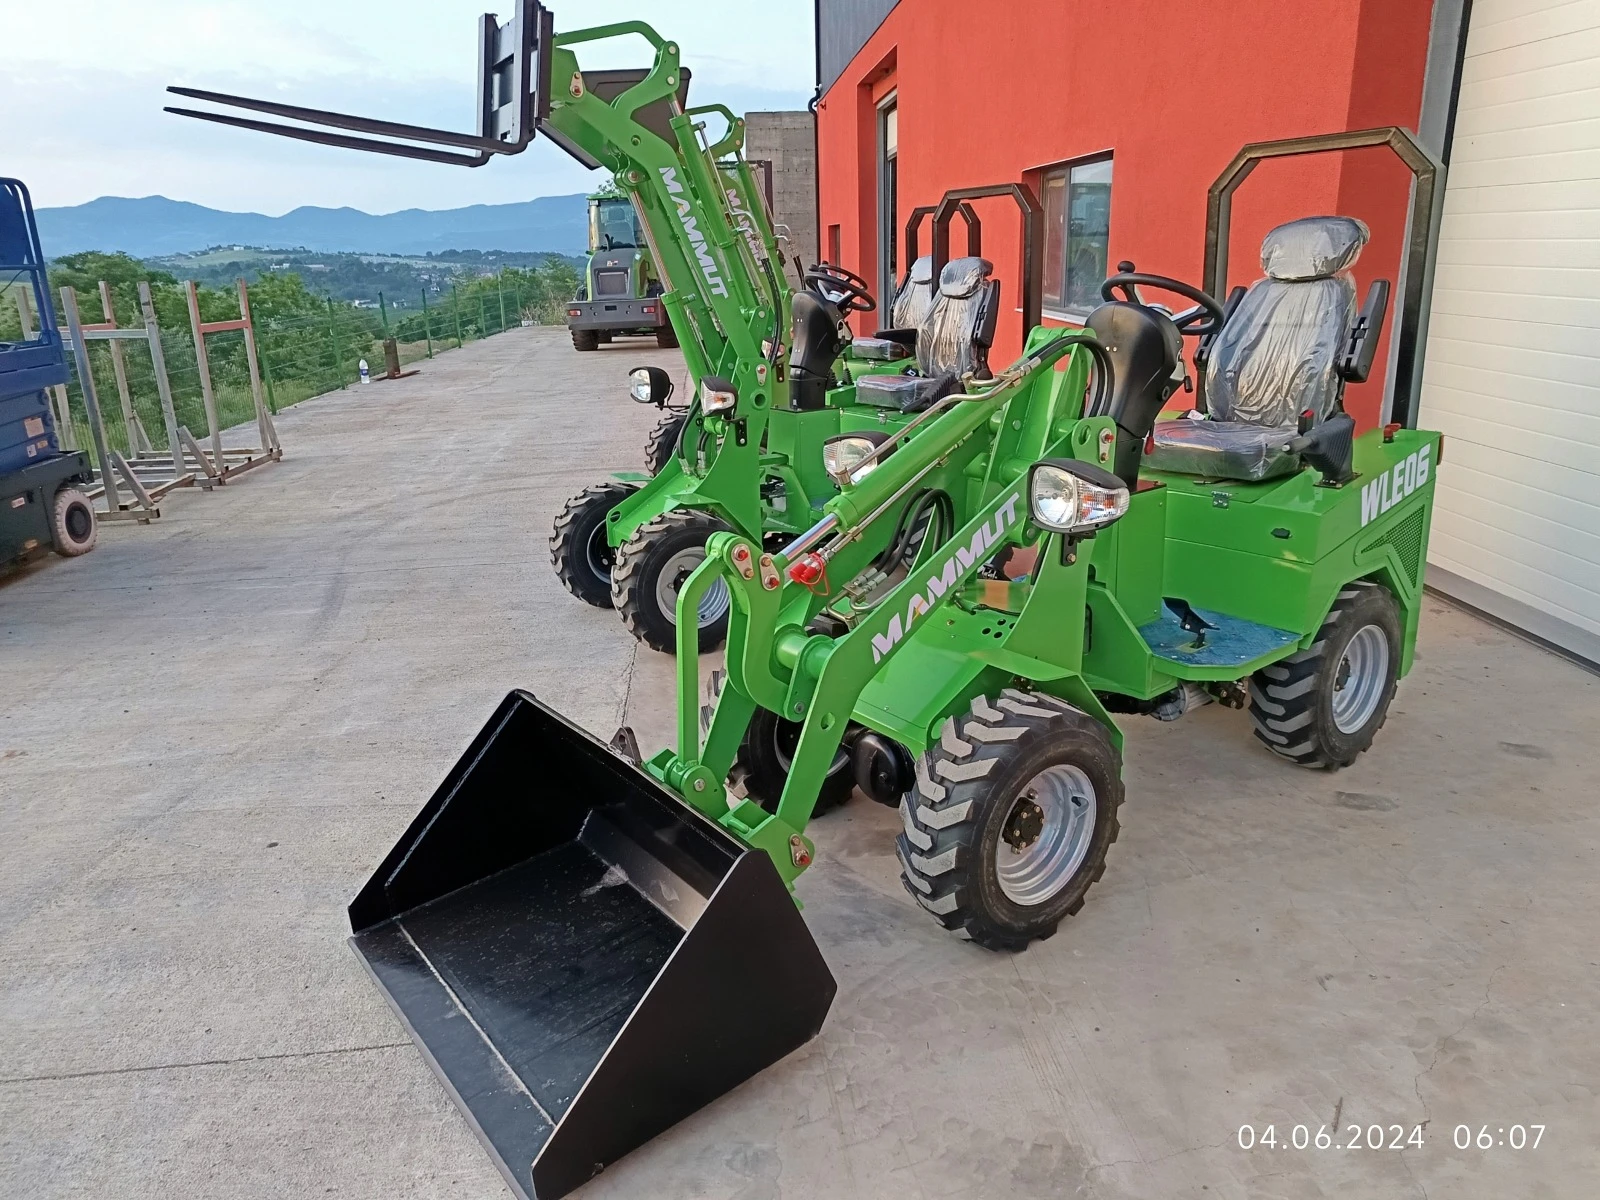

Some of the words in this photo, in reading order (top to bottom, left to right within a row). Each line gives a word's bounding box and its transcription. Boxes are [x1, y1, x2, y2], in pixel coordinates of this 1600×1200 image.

[659, 167, 729, 299] MAMMUT
[1361, 443, 1431, 528] WLE06
[871, 492, 1020, 665] MAMMUT
